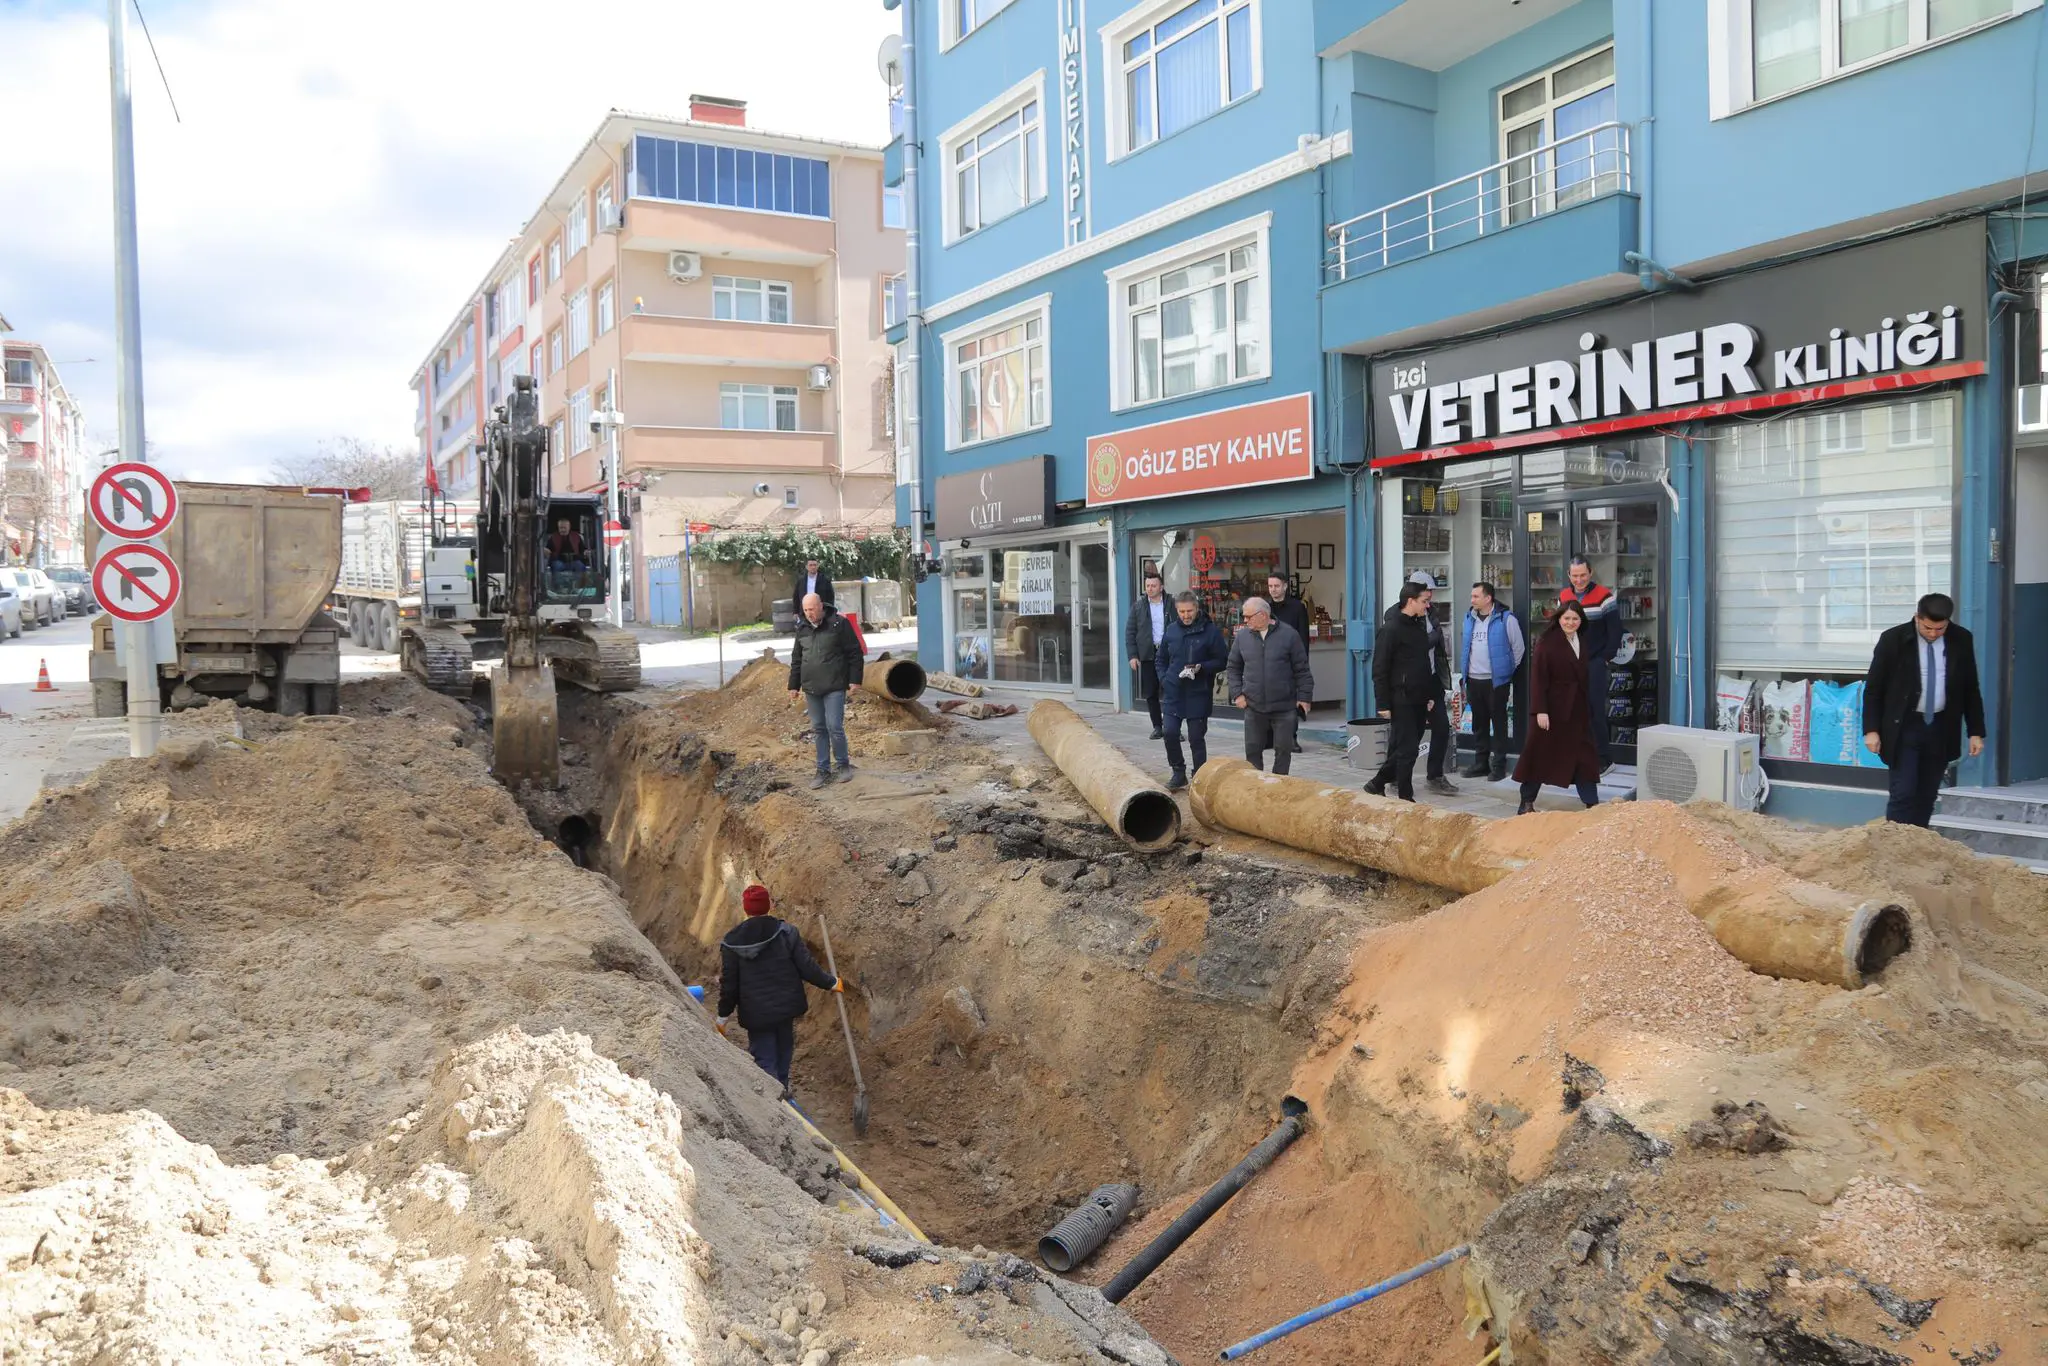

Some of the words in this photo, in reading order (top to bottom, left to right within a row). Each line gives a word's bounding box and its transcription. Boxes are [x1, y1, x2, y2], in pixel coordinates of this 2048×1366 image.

[1389, 331, 1763, 450] VETERİNER
[1774, 305, 1957, 388] KLİNİĞİ
[1125, 448, 1177, 480] OĞUZ
[1182, 442, 1222, 471] BEY
[1227, 427, 1303, 464] KAHVE
[970, 502, 1002, 528] ÇATI
[1020, 556, 1052, 571] DEVREN
[1021, 577, 1052, 593] KİRALIK
[1788, 703, 1802, 756] Pancho
[1838, 707, 1853, 761] Pancho
